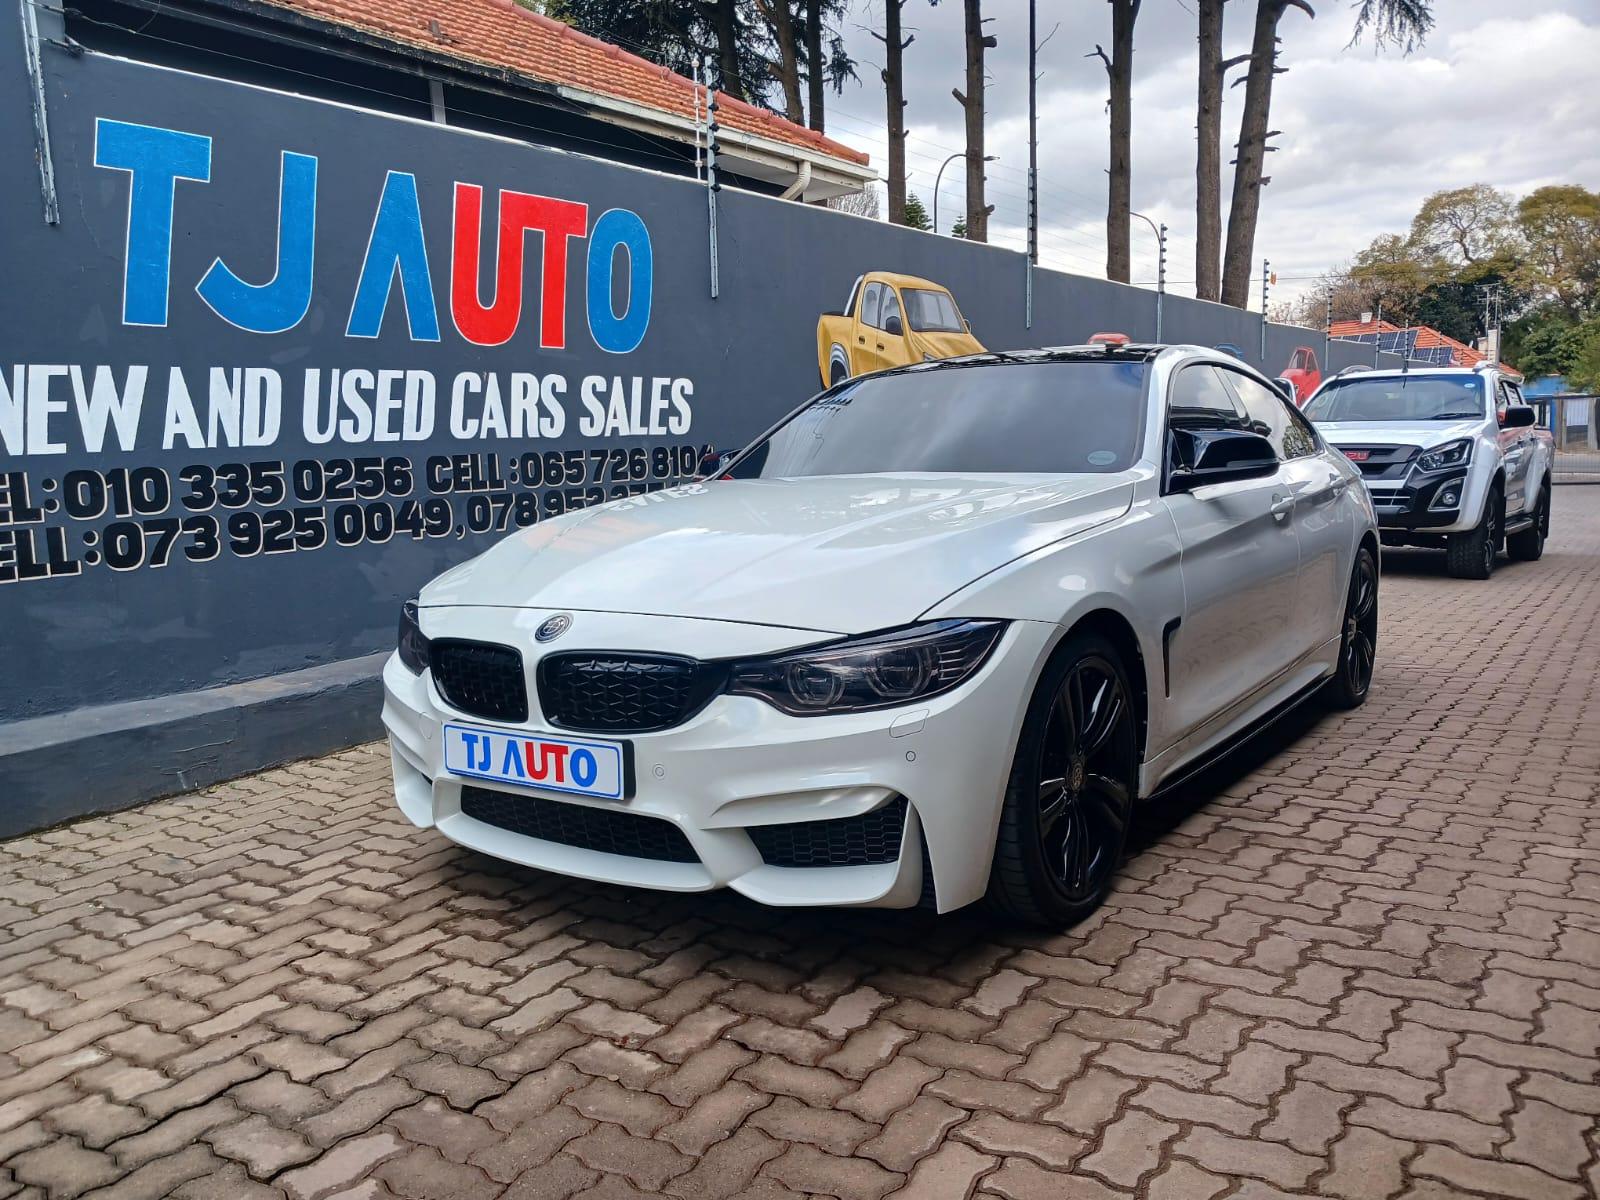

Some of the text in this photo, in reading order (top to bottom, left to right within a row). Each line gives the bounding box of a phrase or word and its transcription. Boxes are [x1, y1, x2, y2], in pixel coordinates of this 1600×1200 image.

[94, 117, 653, 354] TJ AUTO
[0, 364, 694, 456] NEW AND USED CARS SALES
[179, 460, 286, 512] 335
[293, 456, 414, 503] 0256
[590, 447, 647, 484] 726
[228, 506, 328, 559] 925
[461, 733, 598, 788] TJ AUTO
